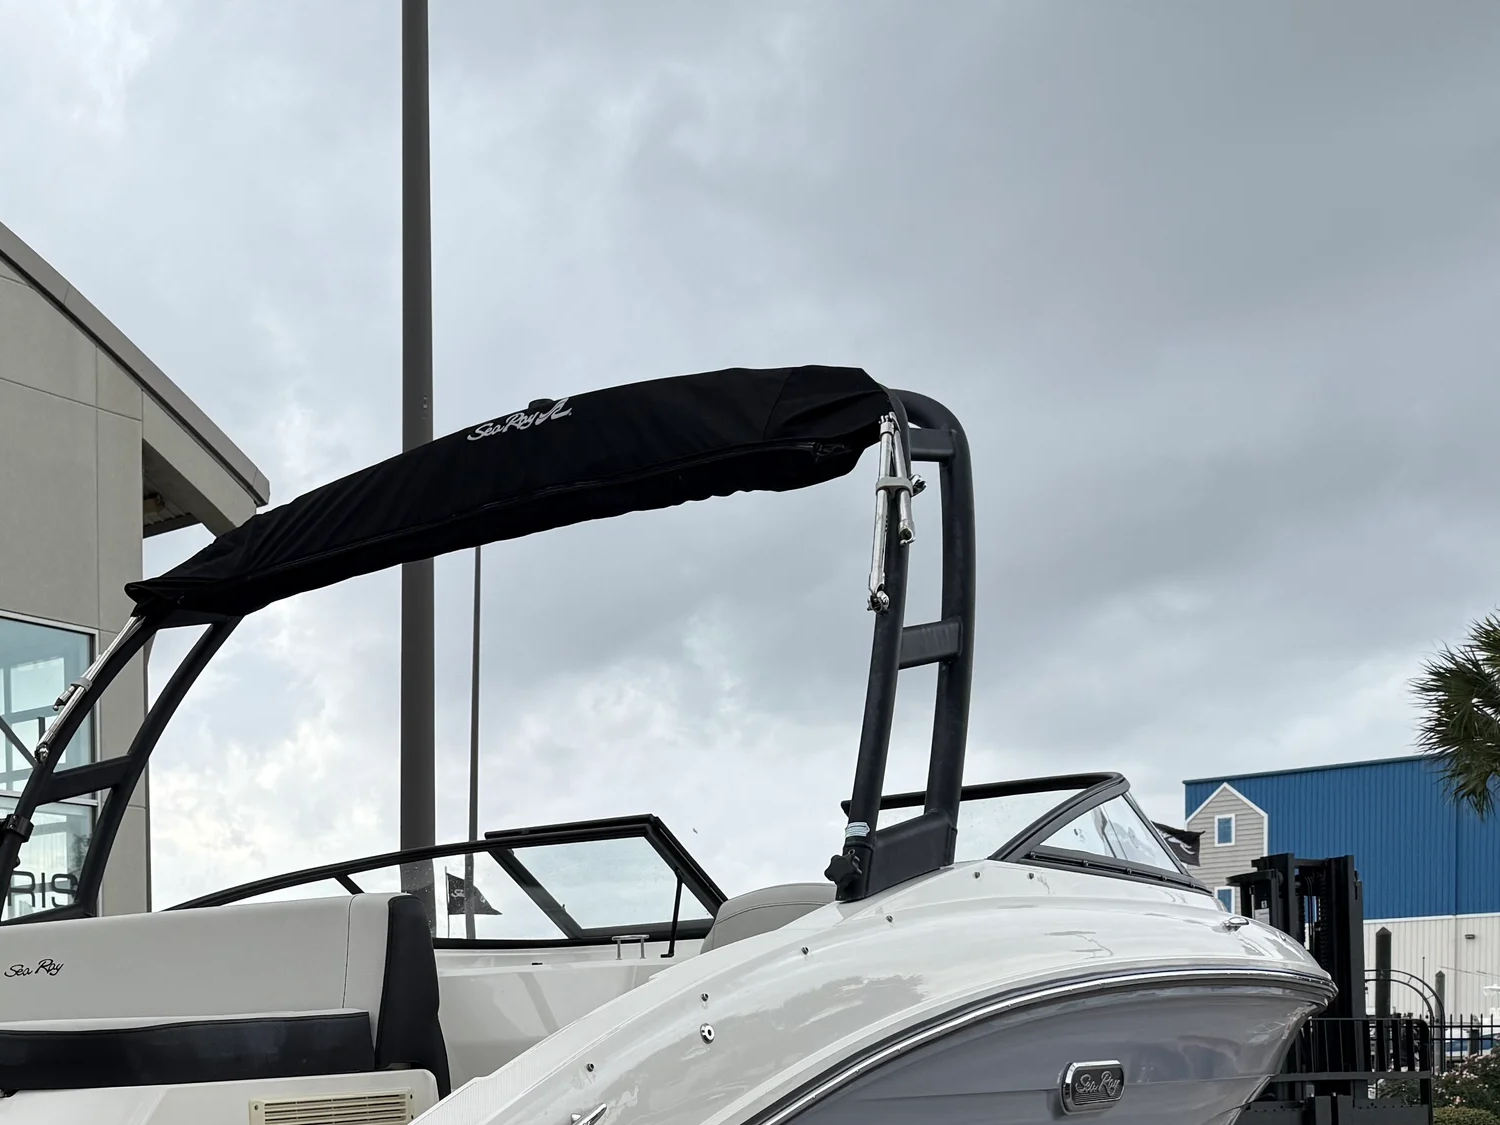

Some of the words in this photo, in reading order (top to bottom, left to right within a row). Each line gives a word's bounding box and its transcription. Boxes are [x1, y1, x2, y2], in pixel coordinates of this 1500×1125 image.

[466, 422, 504, 441] Sea
[502, 411, 540, 433] Ray
[4, 964, 34, 978] Sea
[34, 958, 65, 977] Ray
[1075, 1073, 1099, 1094] Sea
[1099, 1070, 1121, 1097] Ray
